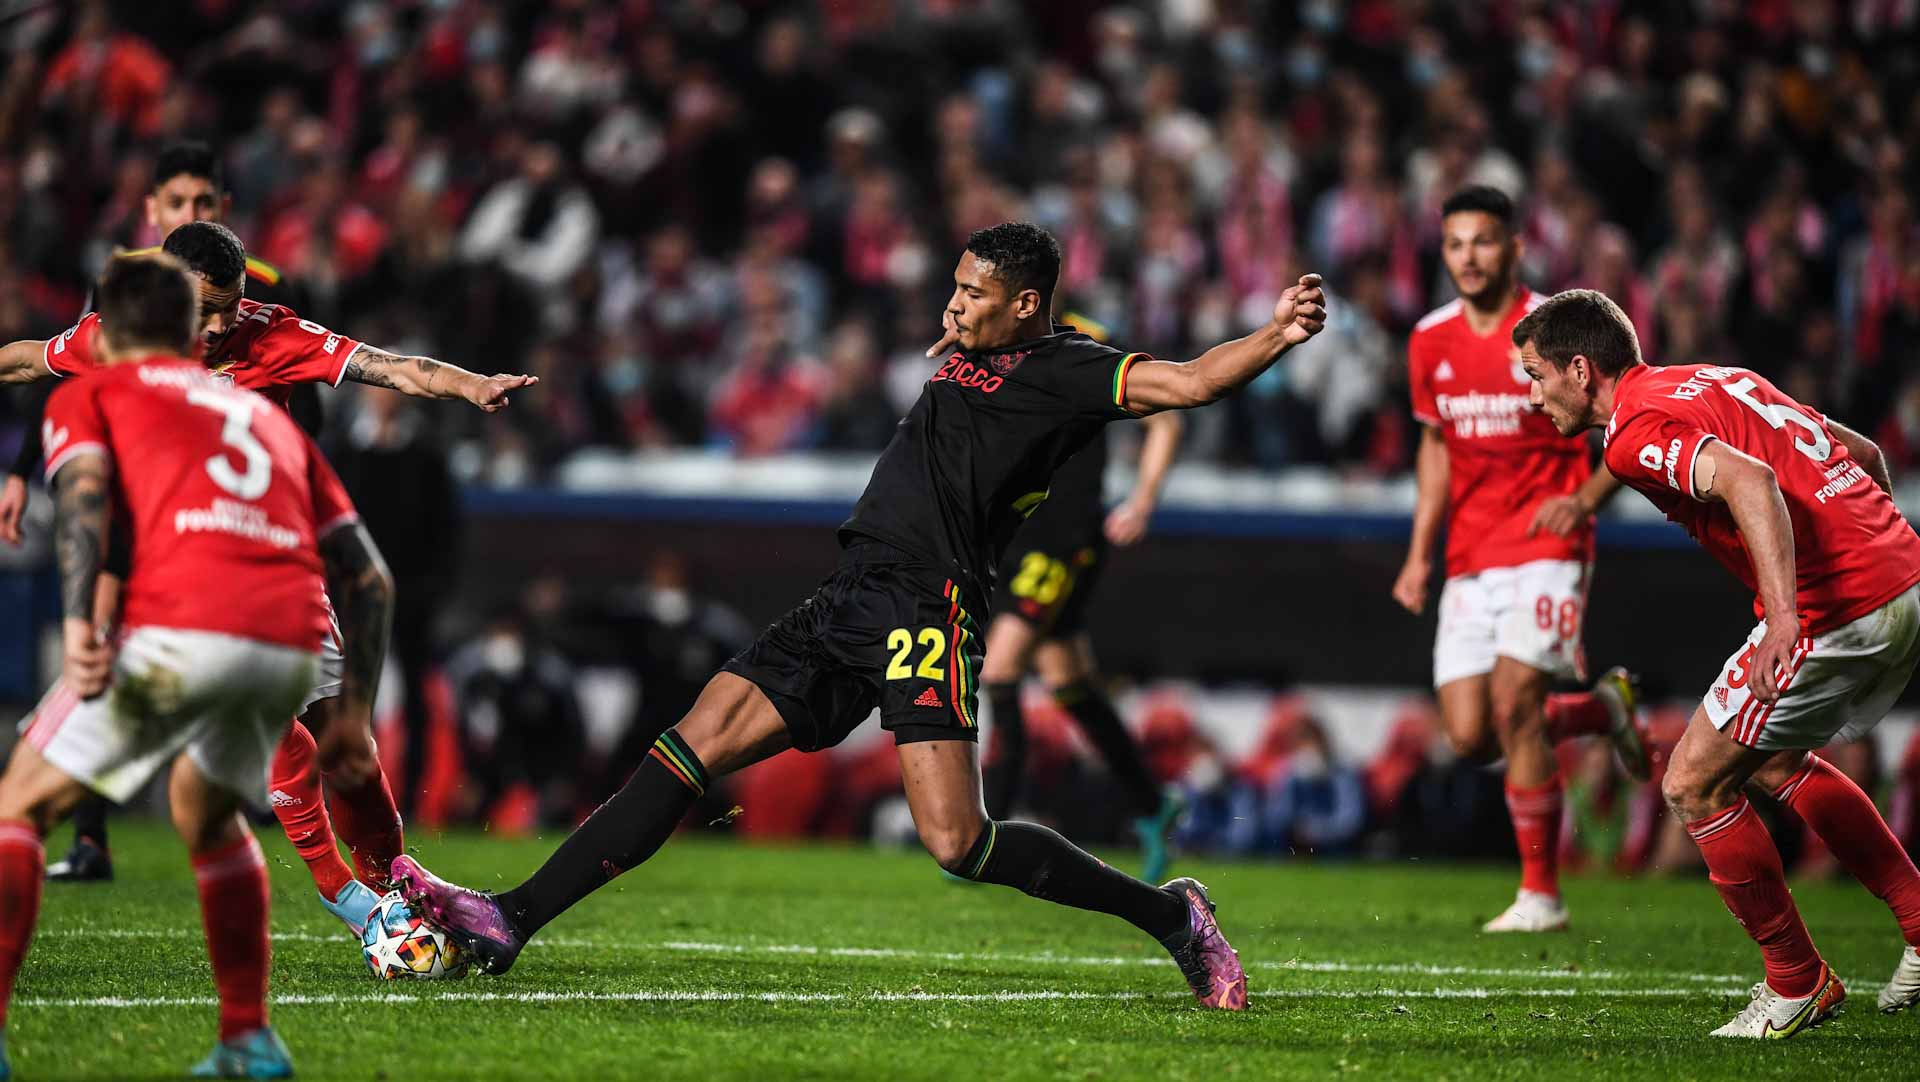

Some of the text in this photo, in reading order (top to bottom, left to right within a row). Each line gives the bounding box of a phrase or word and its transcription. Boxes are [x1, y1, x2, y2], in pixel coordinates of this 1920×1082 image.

[186, 388, 272, 499] 3
[1722, 377, 1831, 462] 5
[1536, 594, 1578, 640] 88
[885, 627, 946, 681] 22
[1727, 642, 1758, 689] 5
[913, 698, 943, 708] adidas
